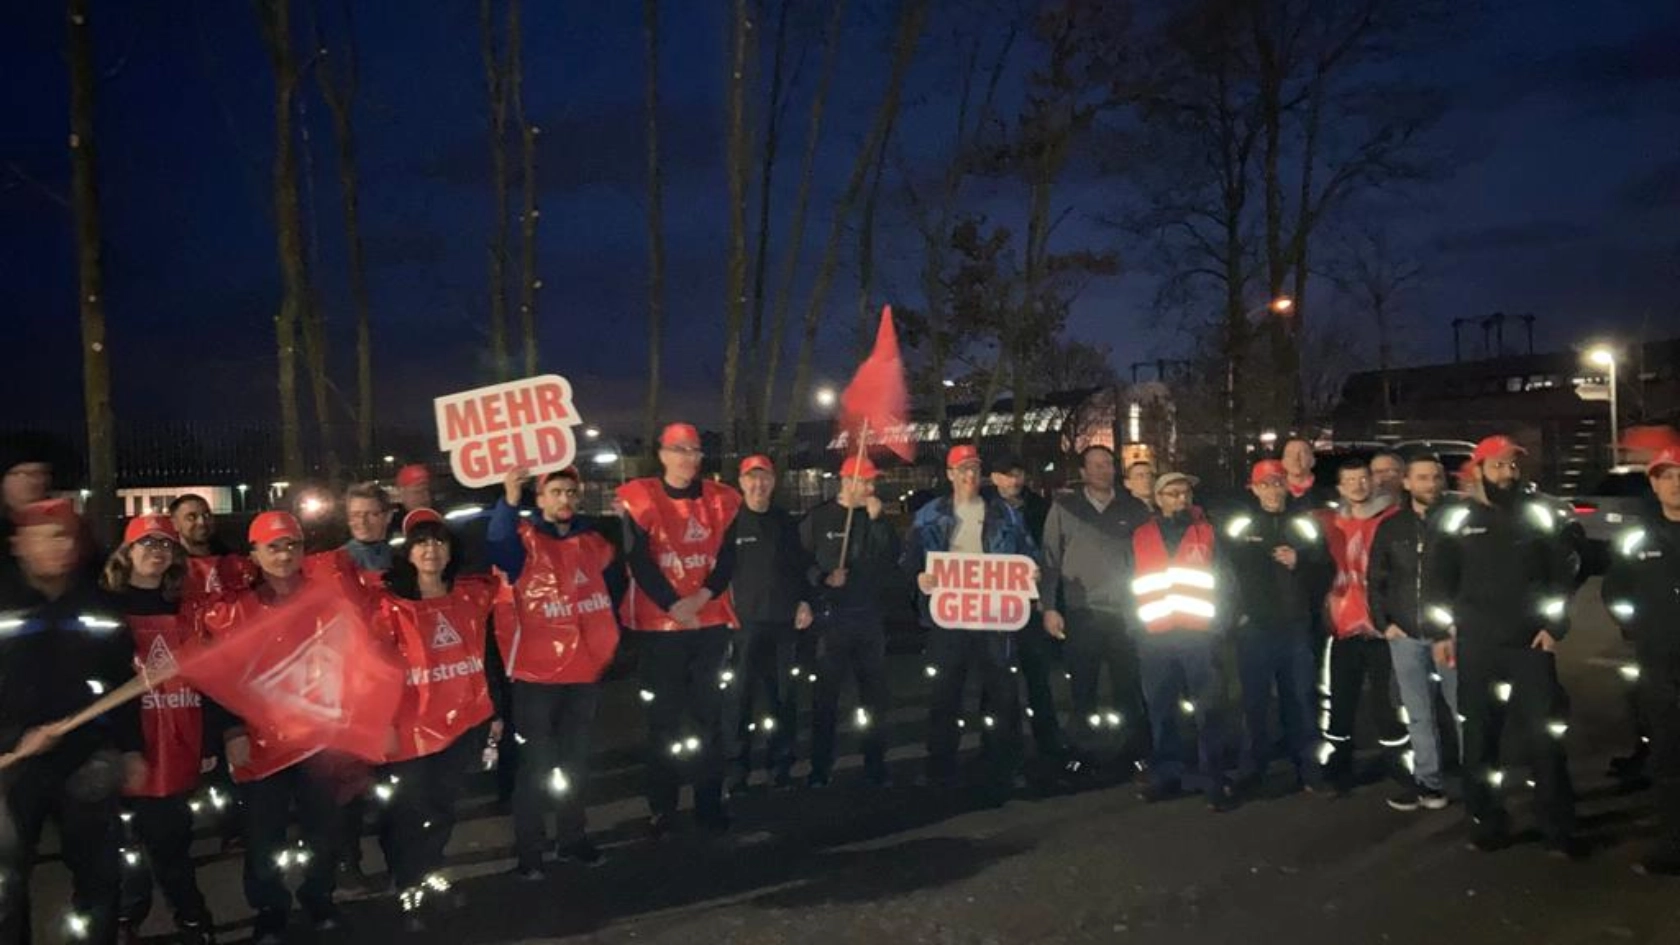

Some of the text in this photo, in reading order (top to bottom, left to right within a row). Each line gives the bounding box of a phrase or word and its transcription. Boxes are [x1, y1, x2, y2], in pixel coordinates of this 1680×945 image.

[444, 382, 568, 441] MEHR
[459, 425, 567, 479] GELD
[933, 559, 1030, 591] MEHR
[937, 592, 1024, 624] GELD
